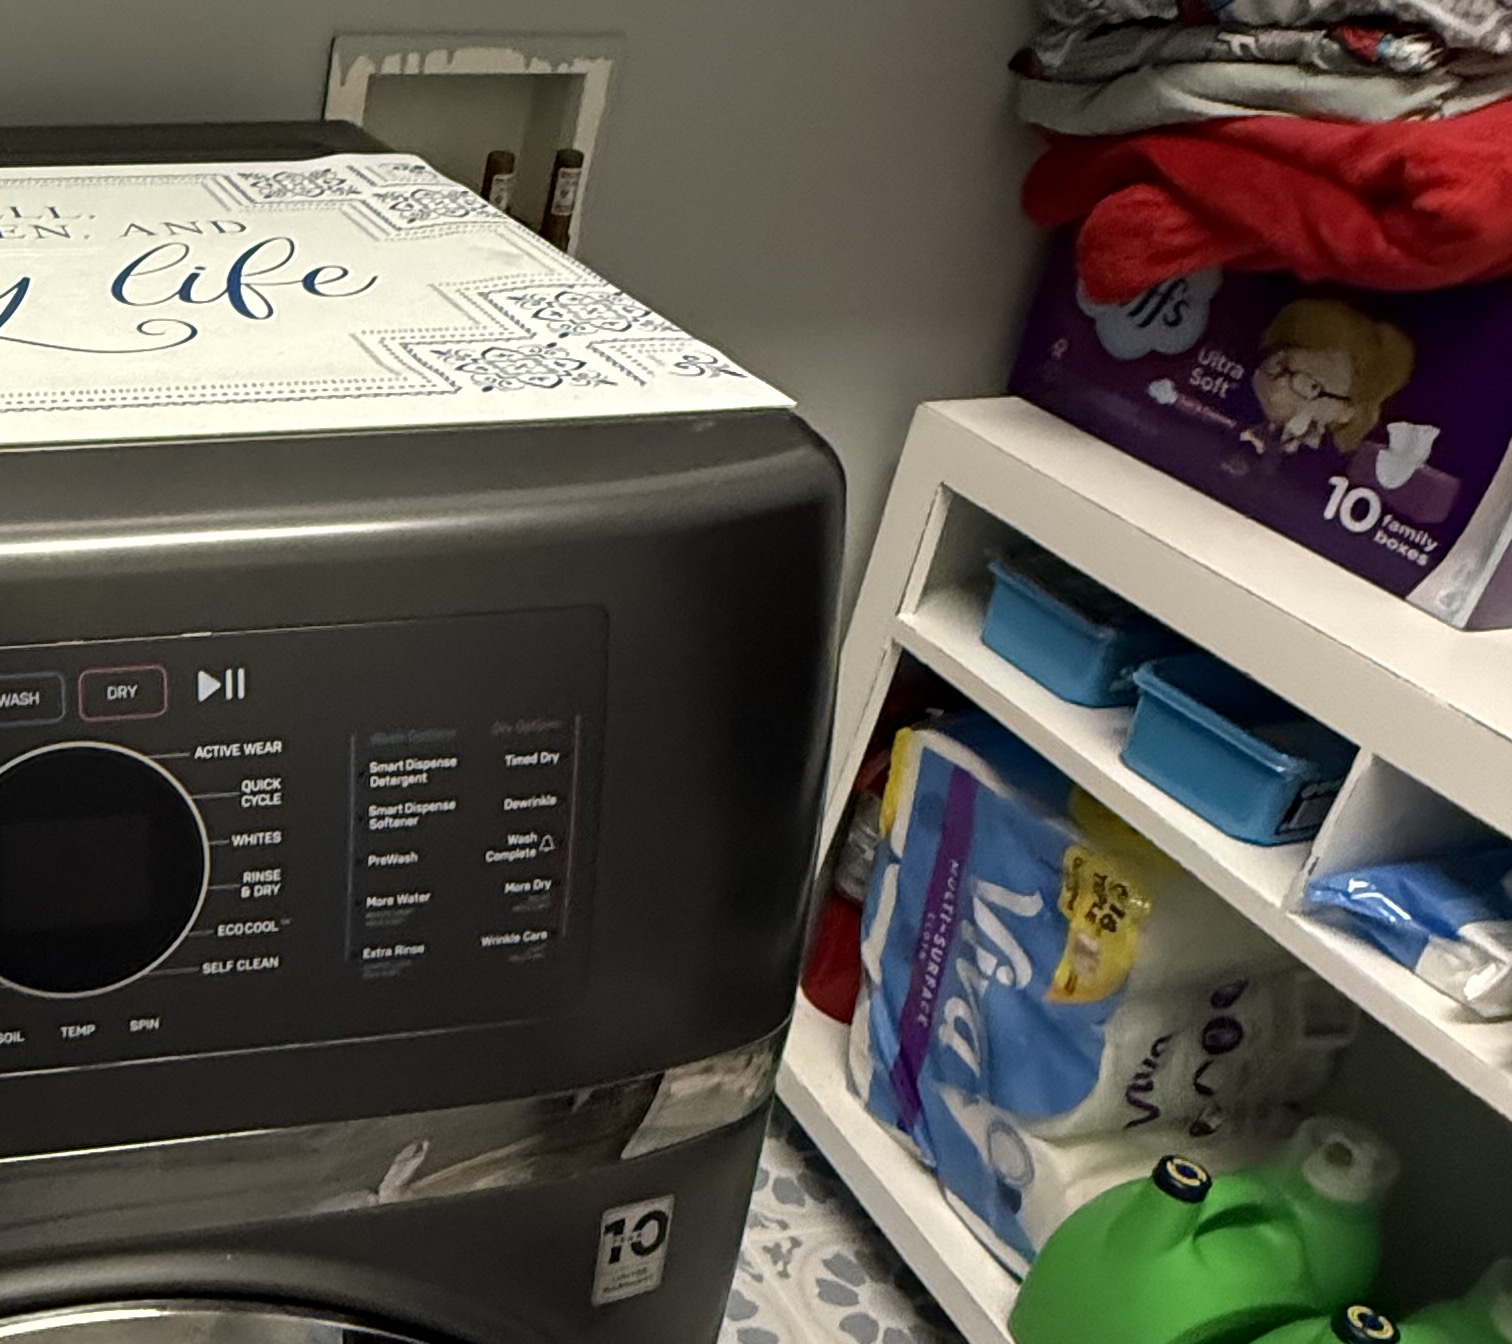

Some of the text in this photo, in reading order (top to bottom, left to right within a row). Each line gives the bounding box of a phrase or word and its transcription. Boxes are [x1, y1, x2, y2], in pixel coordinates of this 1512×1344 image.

[118, 220, 248, 238] AND
[111, 237, 379, 321] life
[1197, 346, 1245, 380] Ultra
[1189, 366, 1230, 399] Soft
[1323, 476, 1382, 533] 10
[1381, 514, 1439, 552] family
[1373, 529, 1429, 567] boxes
[106, 685, 138, 701] DRY
[194, 740, 282, 760] ACTIVE WEAR
[369, 757, 458, 774] Smart Dispense
[504, 751, 560, 768] Timed Dry
[241, 777, 282, 794] QUICK
[369, 772, 428, 788] Detergent
[241, 792, 282, 808] CYCLE
[368, 800, 457, 817] Smart Dispense
[503, 795, 558, 811] Dewrinkle
[369, 816, 419, 830] Softener
[231, 831, 282, 847] WHITES
[507, 832, 538, 846] Wash
[367, 852, 419, 867] PreWash
[485, 847, 537, 864] Complete
[242, 869, 282, 883] RINSE
[253, 883, 282, 897] DRY
[504, 878, 552, 894] More Dry
[366, 891, 432, 908] More Water
[480, 929, 548, 946] Wrinkle Care
[916, 858, 960, 1028] MULTI-SURFACE
[362, 943, 425, 960] Extra Rinse
[202, 955, 280, 975] SELF CLEAN
[939, 874, 1045, 1079] Viva
[60, 1024, 96, 1039] TEMP
[129, 1018, 160, 1033] SPIN
